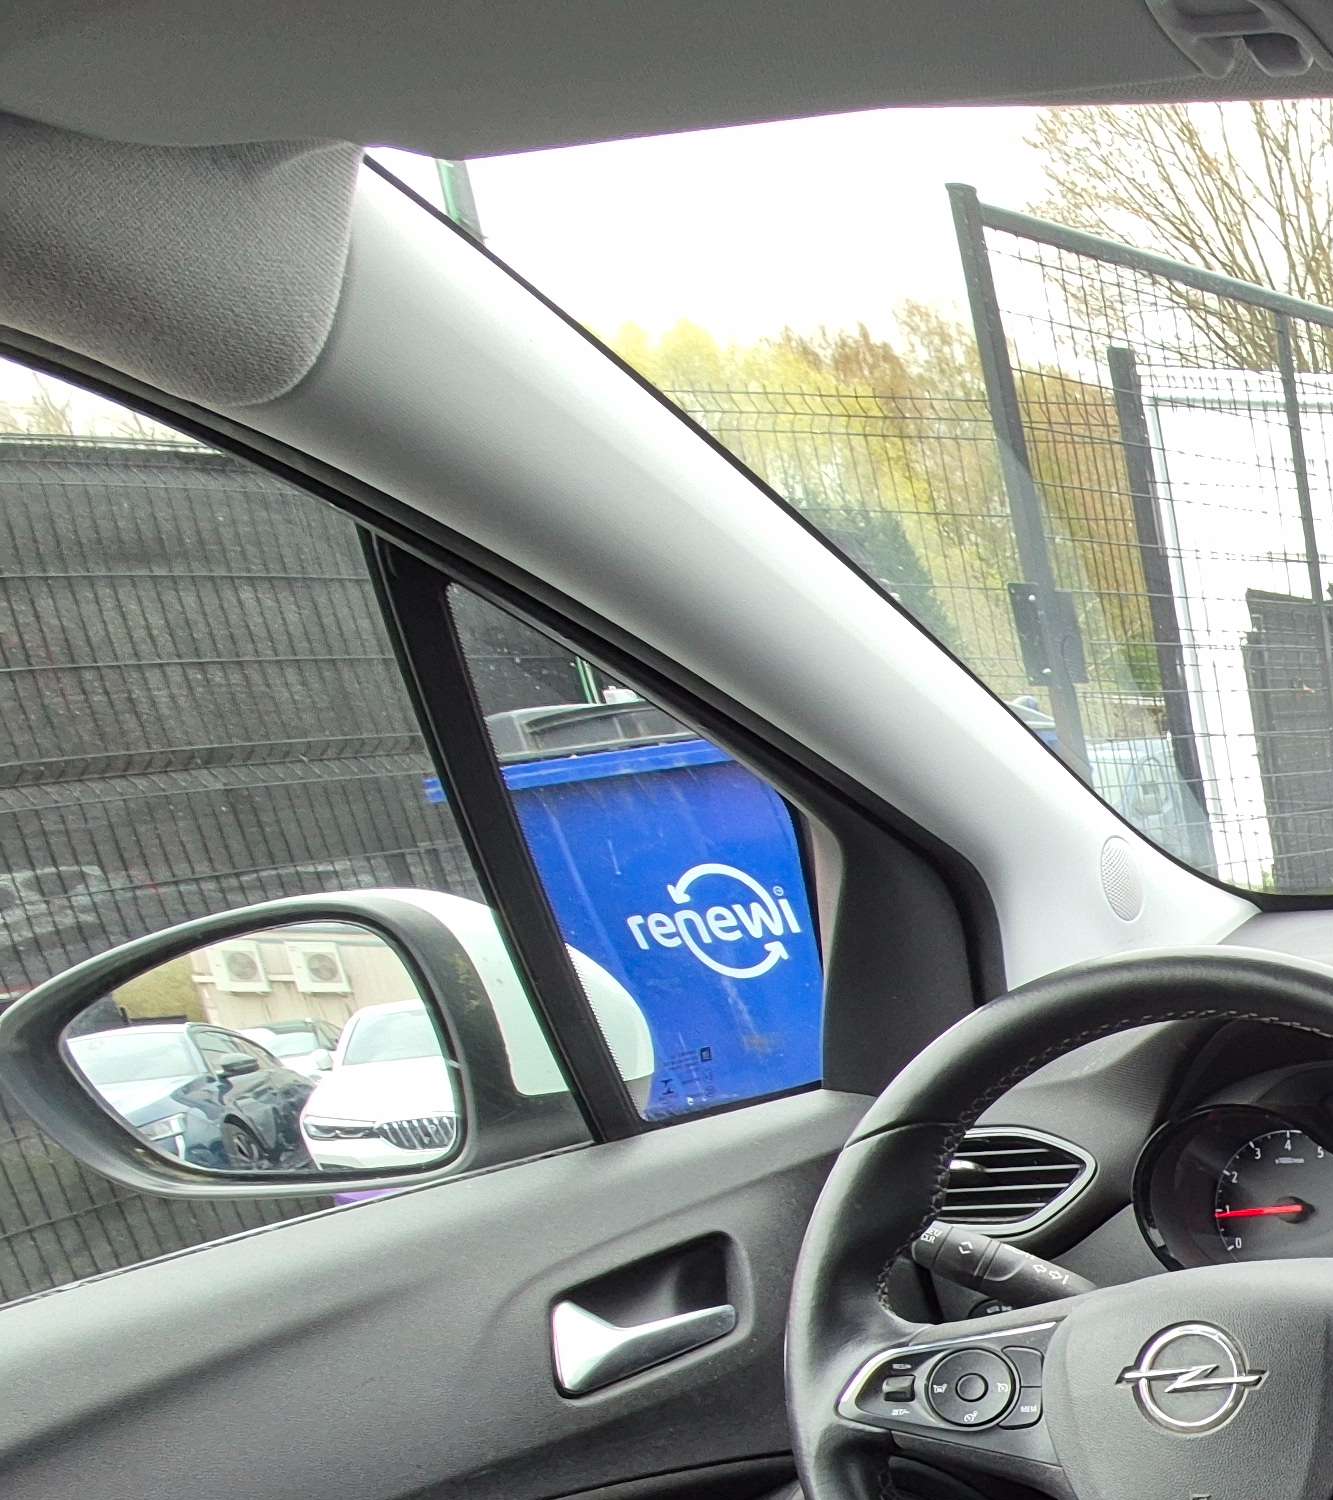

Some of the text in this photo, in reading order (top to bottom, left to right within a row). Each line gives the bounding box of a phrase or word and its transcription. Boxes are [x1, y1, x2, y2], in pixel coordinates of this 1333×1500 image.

[627, 896, 801, 951] renewi
[1284, 1139, 1291, 1151] 4
[1254, 1148, 1261, 1160] 3
[1317, 1147, 1324, 1159] 5
[1231, 1171, 1239, 1184] 2
[1235, 1241, 1242, 1249] 0
